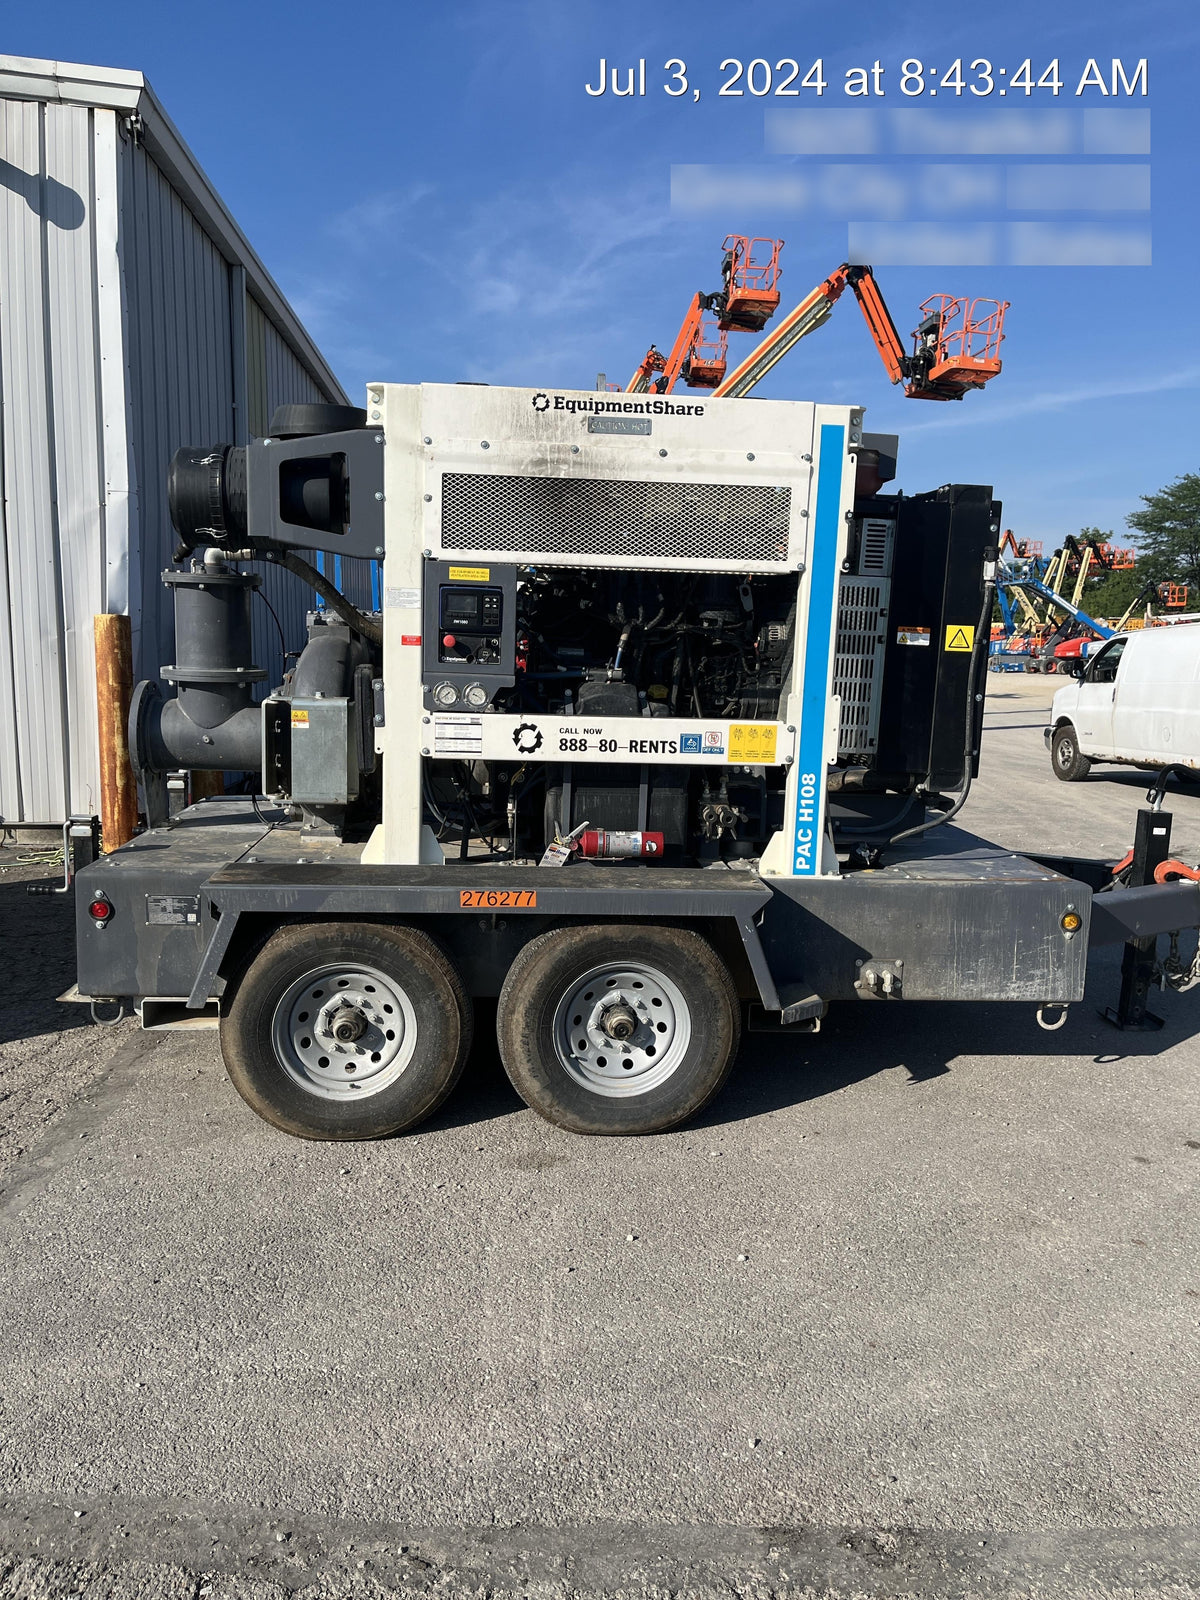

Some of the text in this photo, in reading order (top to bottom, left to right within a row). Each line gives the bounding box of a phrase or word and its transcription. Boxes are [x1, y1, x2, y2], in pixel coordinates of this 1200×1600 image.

[553, 395, 705, 416] EquipmentShare
[631, 423, 649, 431] HOT
[559, 727, 580, 735] CALL
[795, 772, 817, 870] PAC H108
[462, 890, 535, 906] 276277
